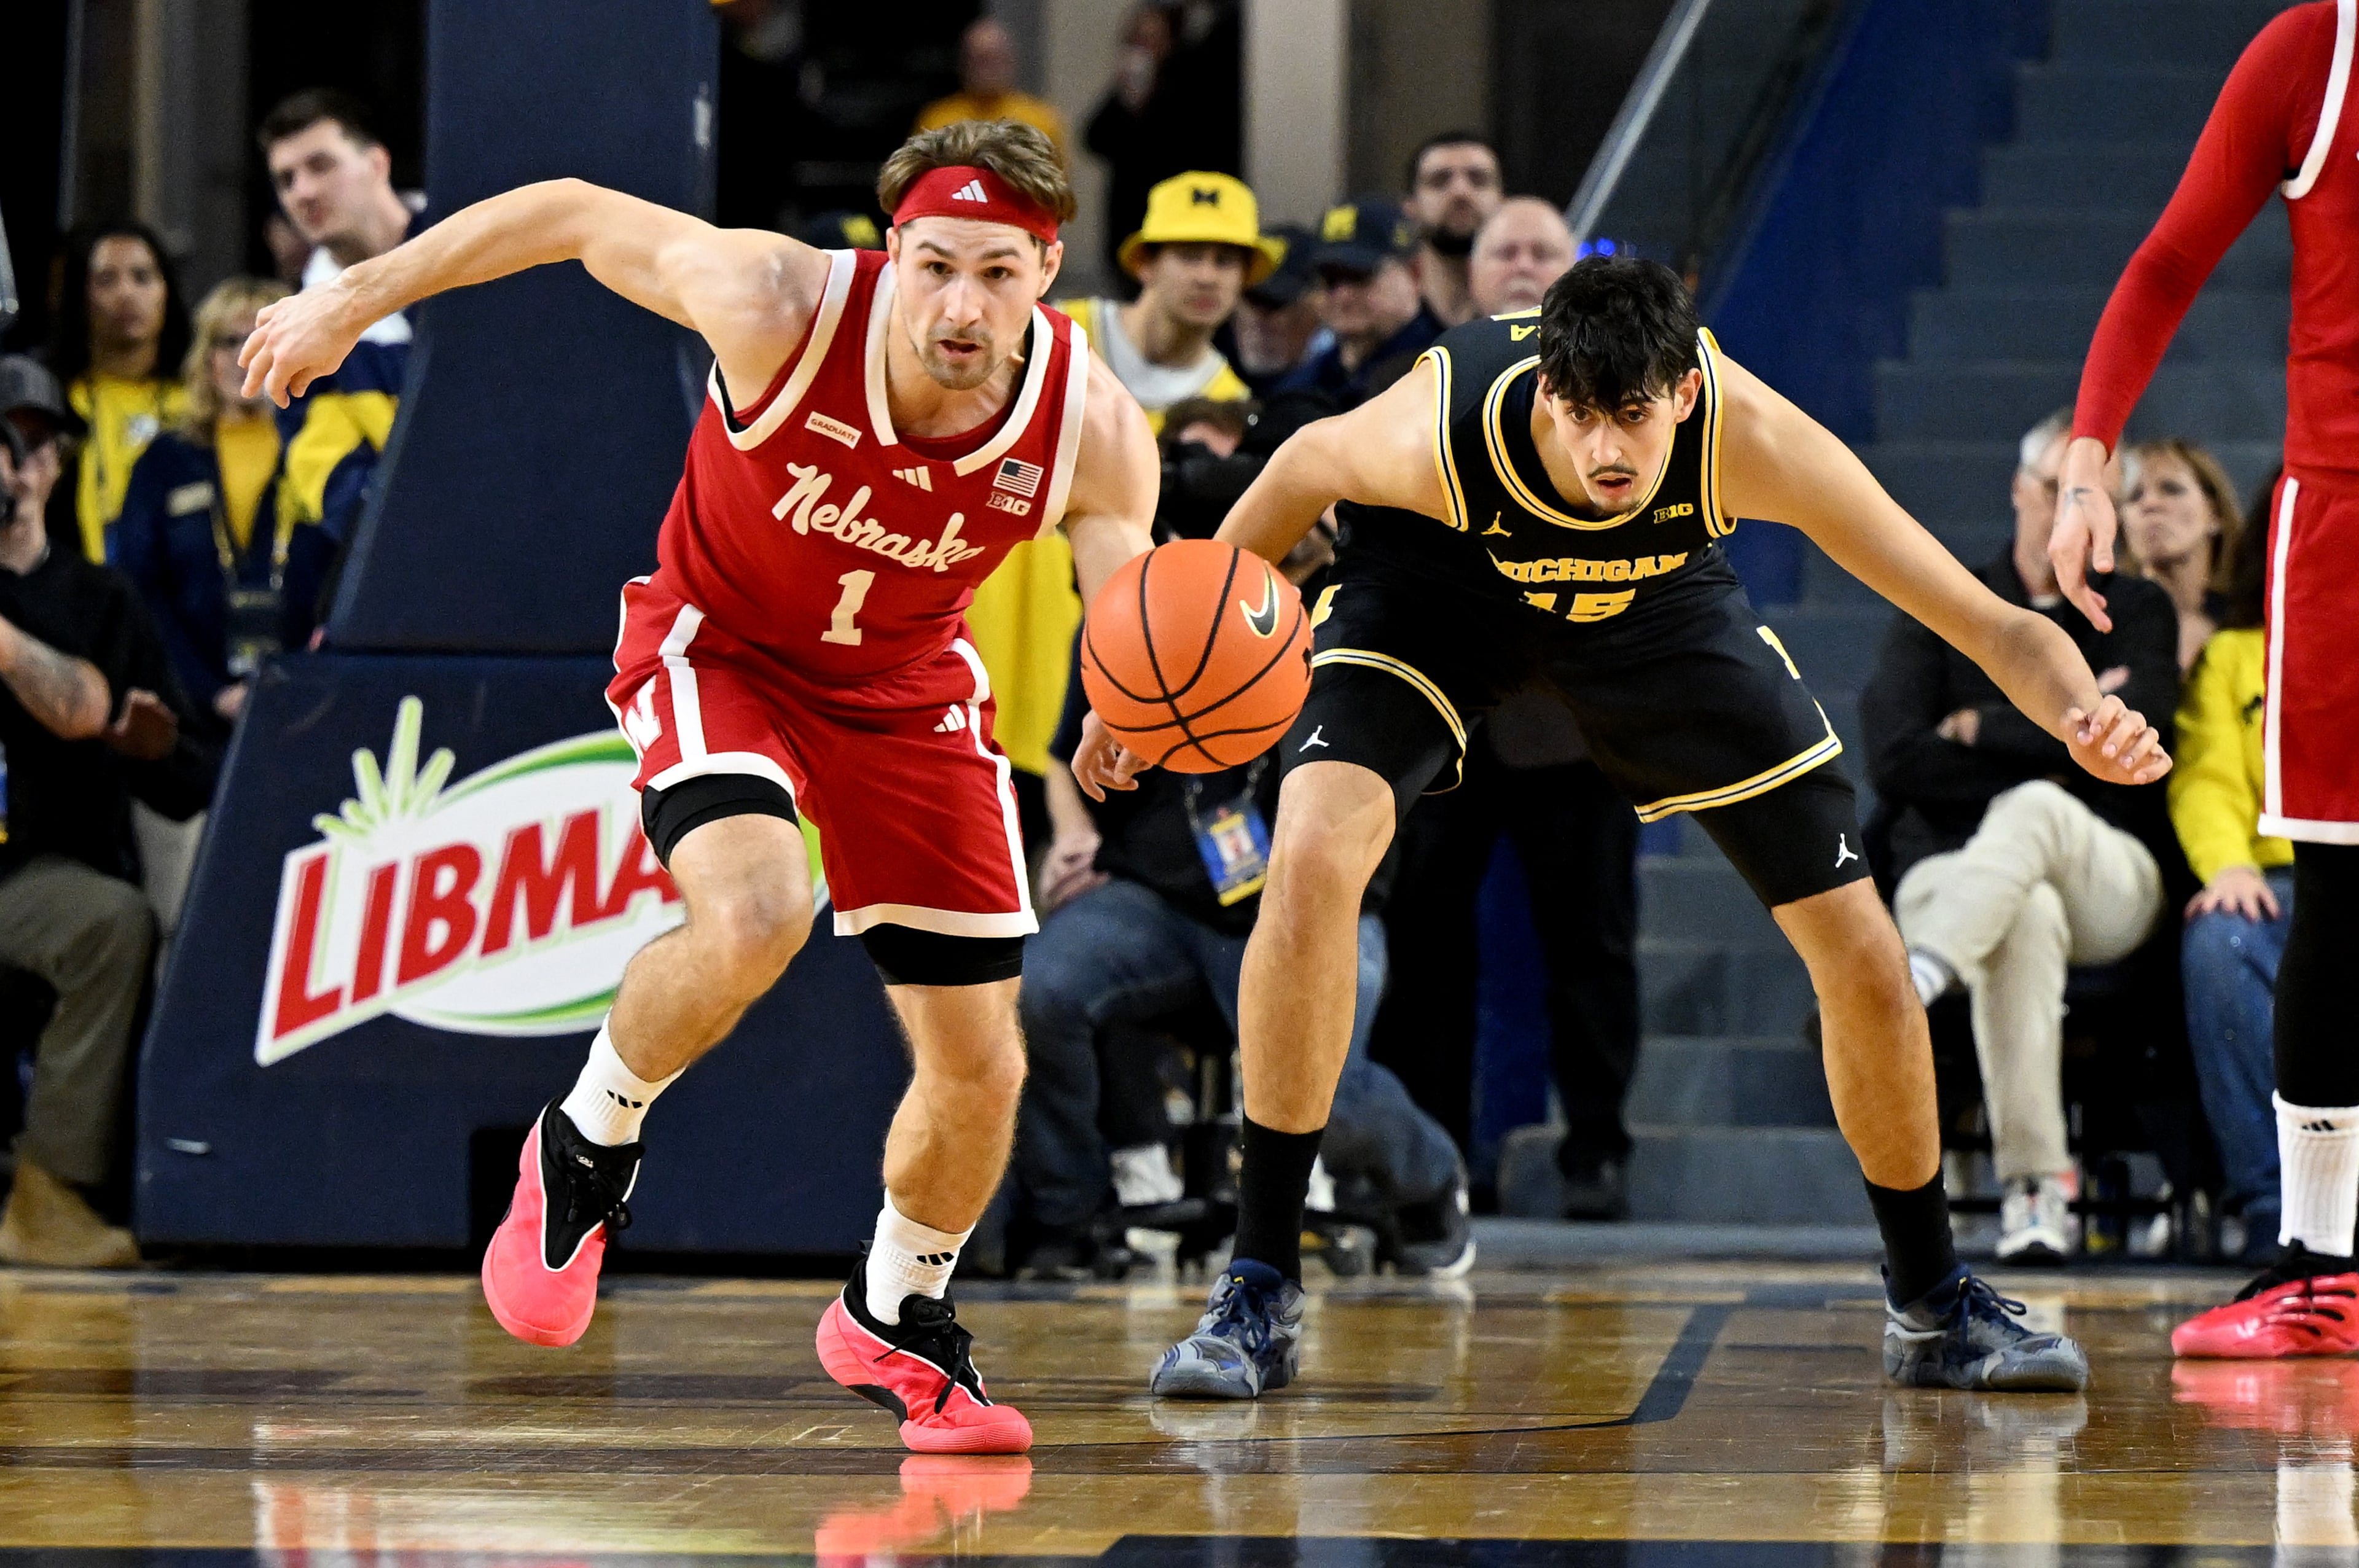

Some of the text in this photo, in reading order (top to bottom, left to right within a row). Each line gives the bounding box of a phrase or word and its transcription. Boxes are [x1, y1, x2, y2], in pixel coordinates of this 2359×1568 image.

[810, 418, 856, 442] GRADUATE
[772, 462, 986, 572] Nebraska
[821, 569, 875, 646] 1
[272, 809, 682, 1041] LIBMA
